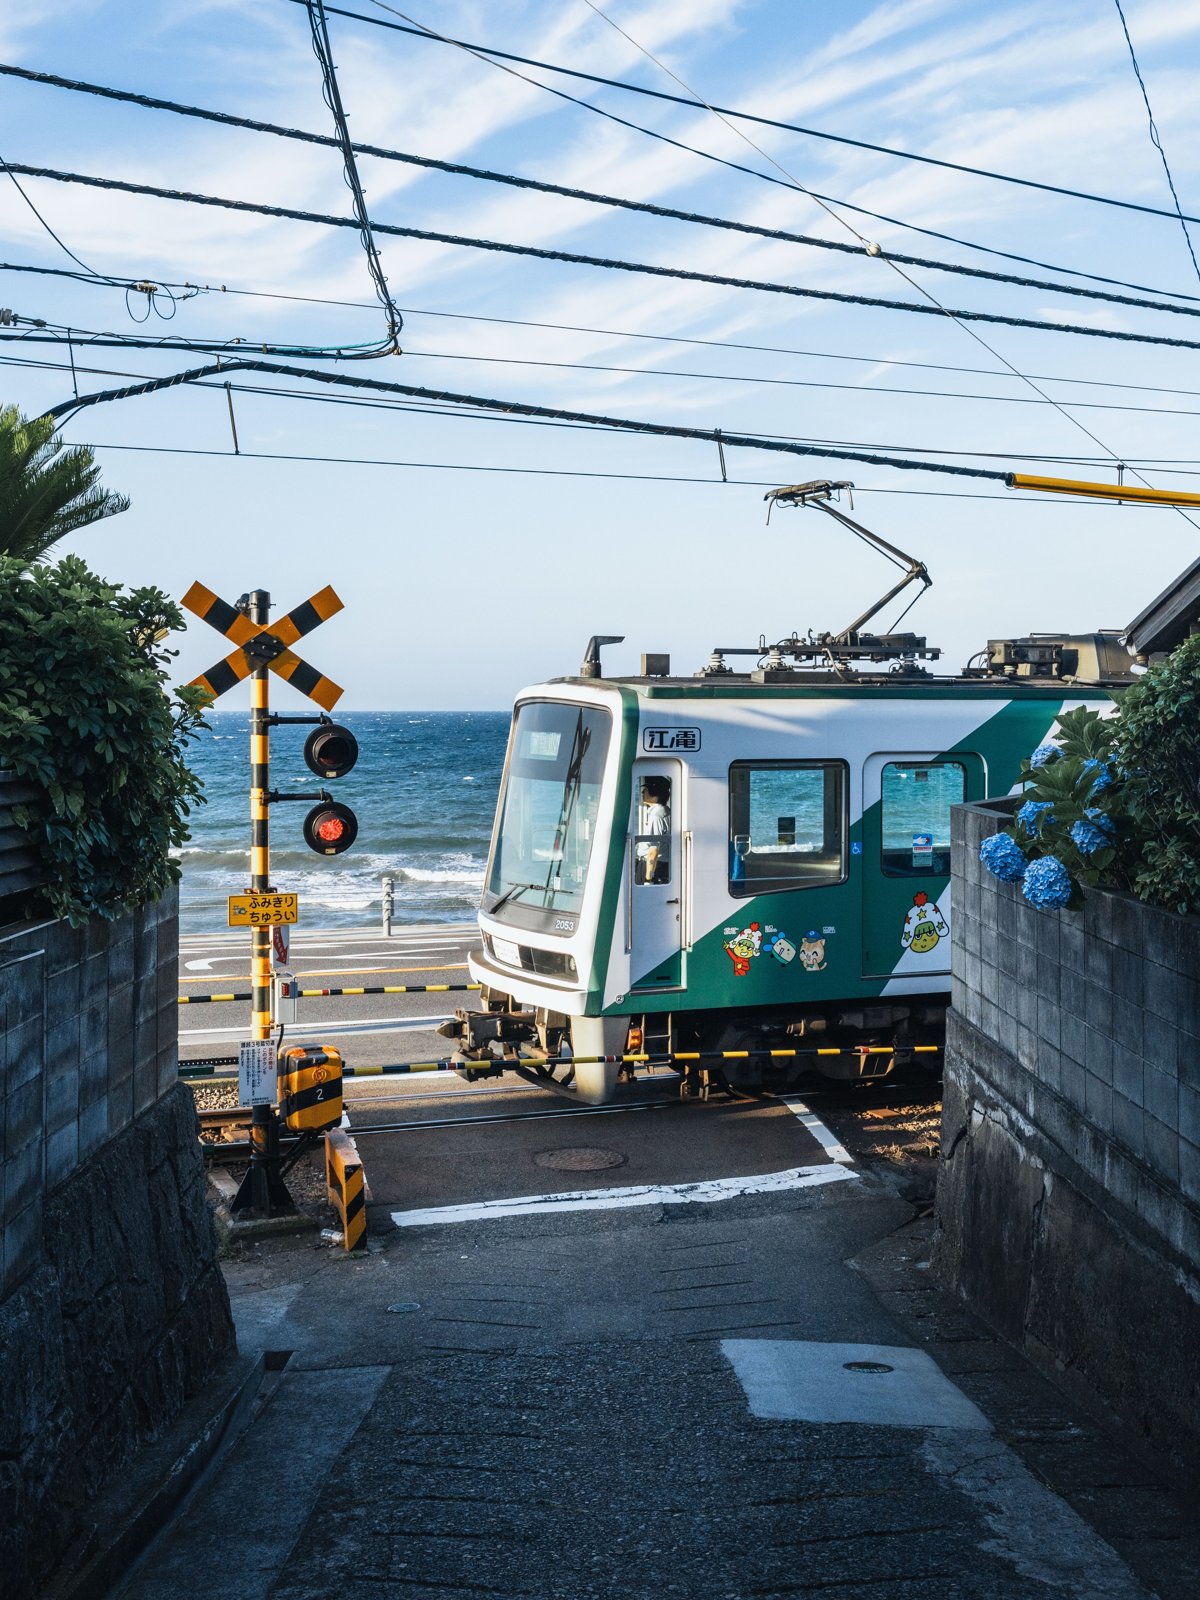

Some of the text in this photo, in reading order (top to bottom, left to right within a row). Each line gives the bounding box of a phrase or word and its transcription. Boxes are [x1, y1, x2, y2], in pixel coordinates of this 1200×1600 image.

[249, 896, 294, 909] ふみきり
[249, 910, 295, 923] ちゅうい
[555, 919, 574, 931] 2053
[315, 1088, 325, 1101] 2
